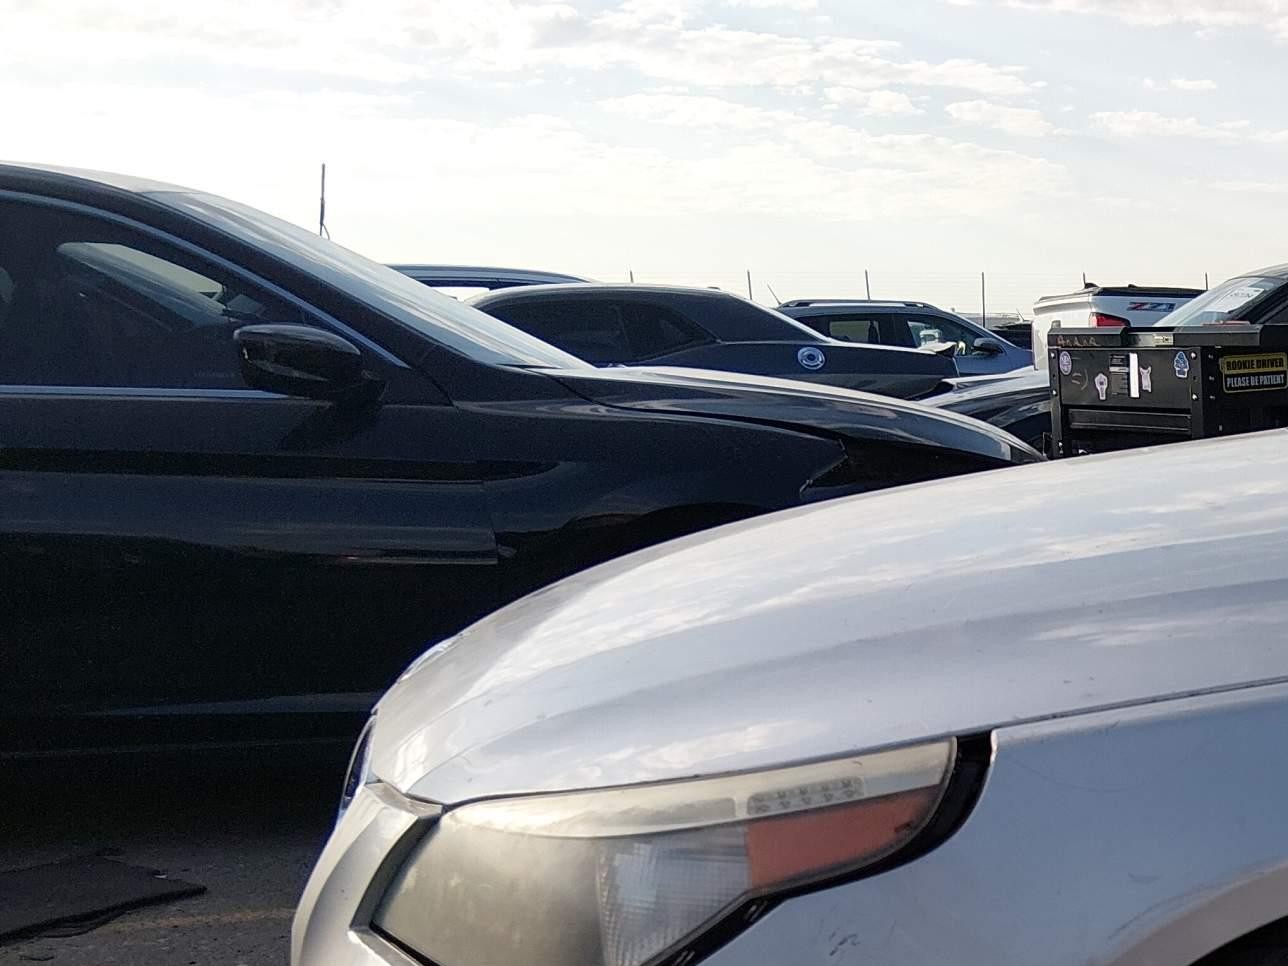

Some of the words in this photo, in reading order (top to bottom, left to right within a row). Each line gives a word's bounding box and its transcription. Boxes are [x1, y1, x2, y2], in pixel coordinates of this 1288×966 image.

[1226, 360, 1255, 370] ROOKIE
[1255, 358, 1284, 369] DRIVER
[1226, 376, 1250, 388] PLEASE
